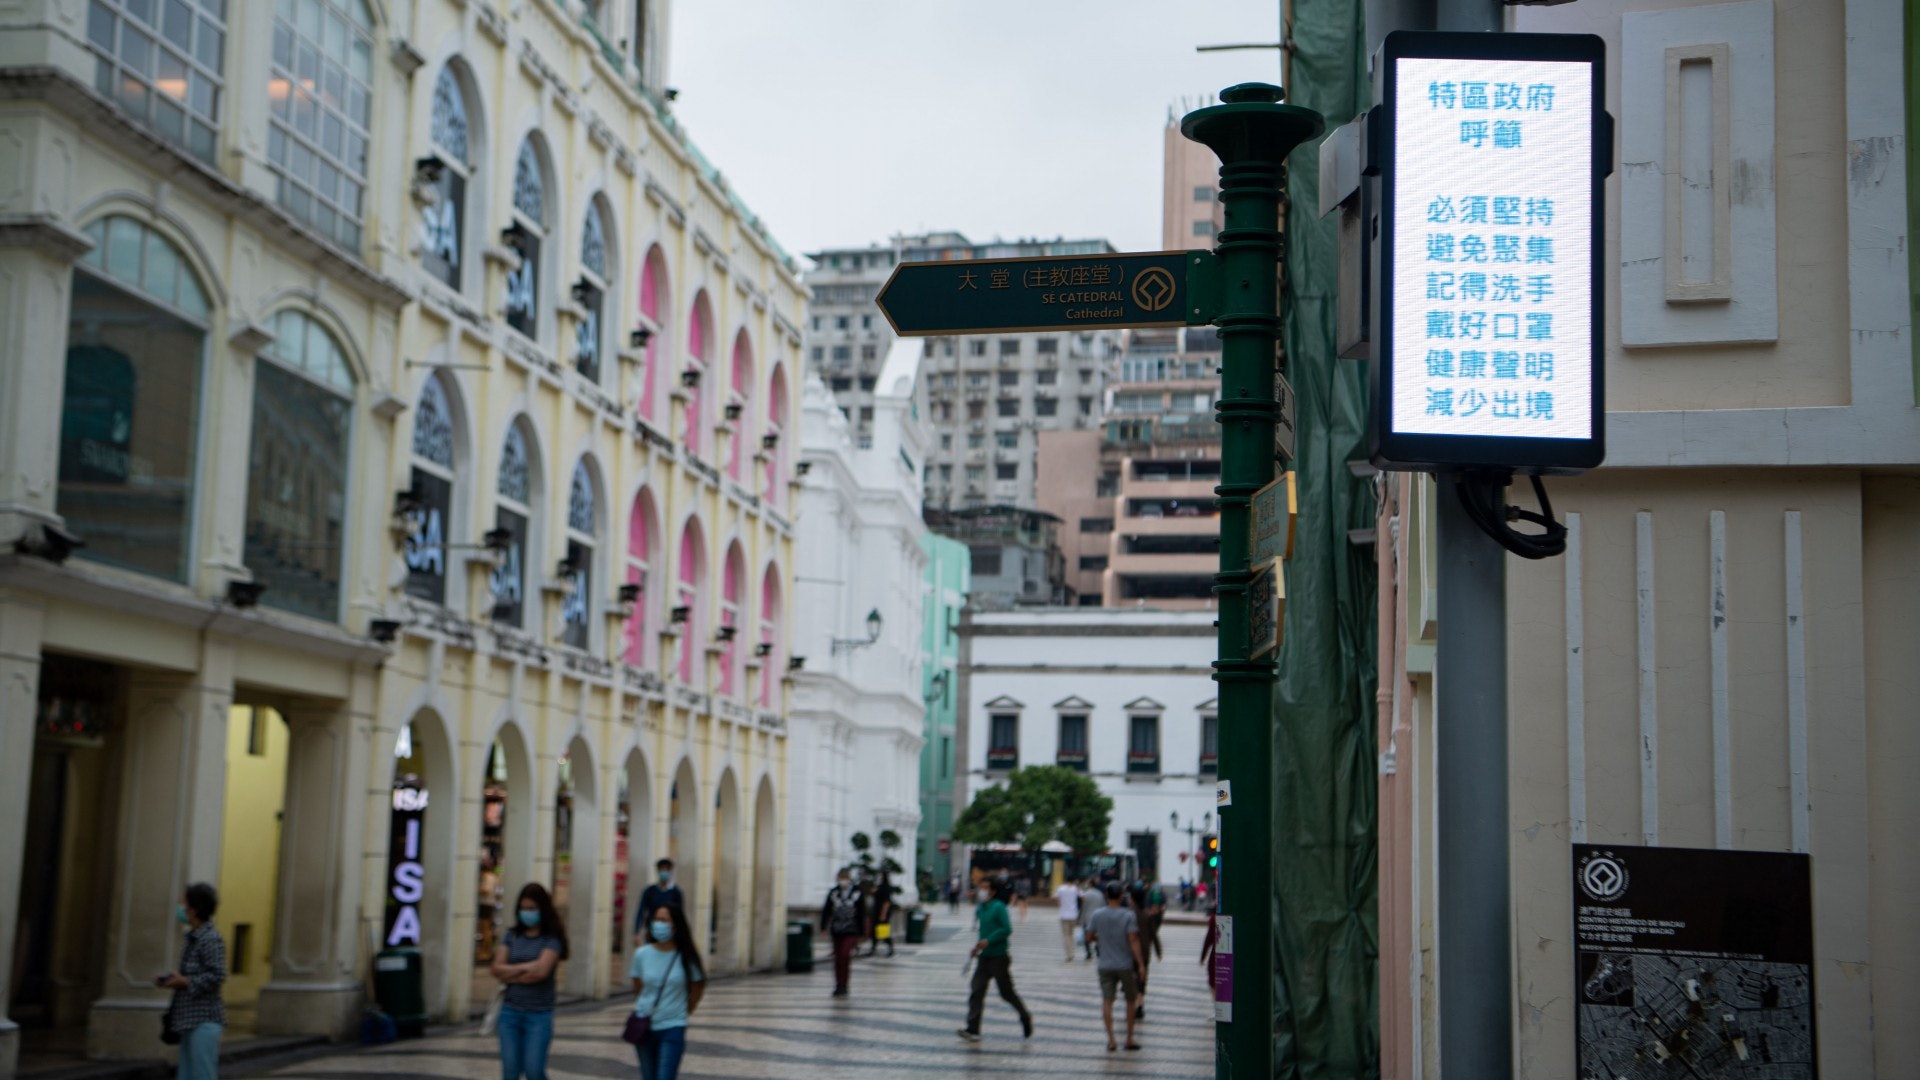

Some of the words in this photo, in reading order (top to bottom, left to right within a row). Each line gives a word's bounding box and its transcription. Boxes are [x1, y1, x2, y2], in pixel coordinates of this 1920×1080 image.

[1428, 80, 1555, 111] 特區政府
[1459, 119, 1522, 149] 呼籲
[1427, 194, 1555, 227] 必須堅持
[1426, 233, 1555, 265] 避免聚集
[1059, 290, 1124, 304] CATEDRAL
[1426, 271, 1554, 303] 記得洗手
[1066, 306, 1124, 320] Cathedral
[1425, 309, 1554, 341] 戴好口罩
[1425, 349, 1554, 382] 健康聲明
[1425, 387, 1555, 420] 減少出境
[387, 818, 425, 946] ISA
